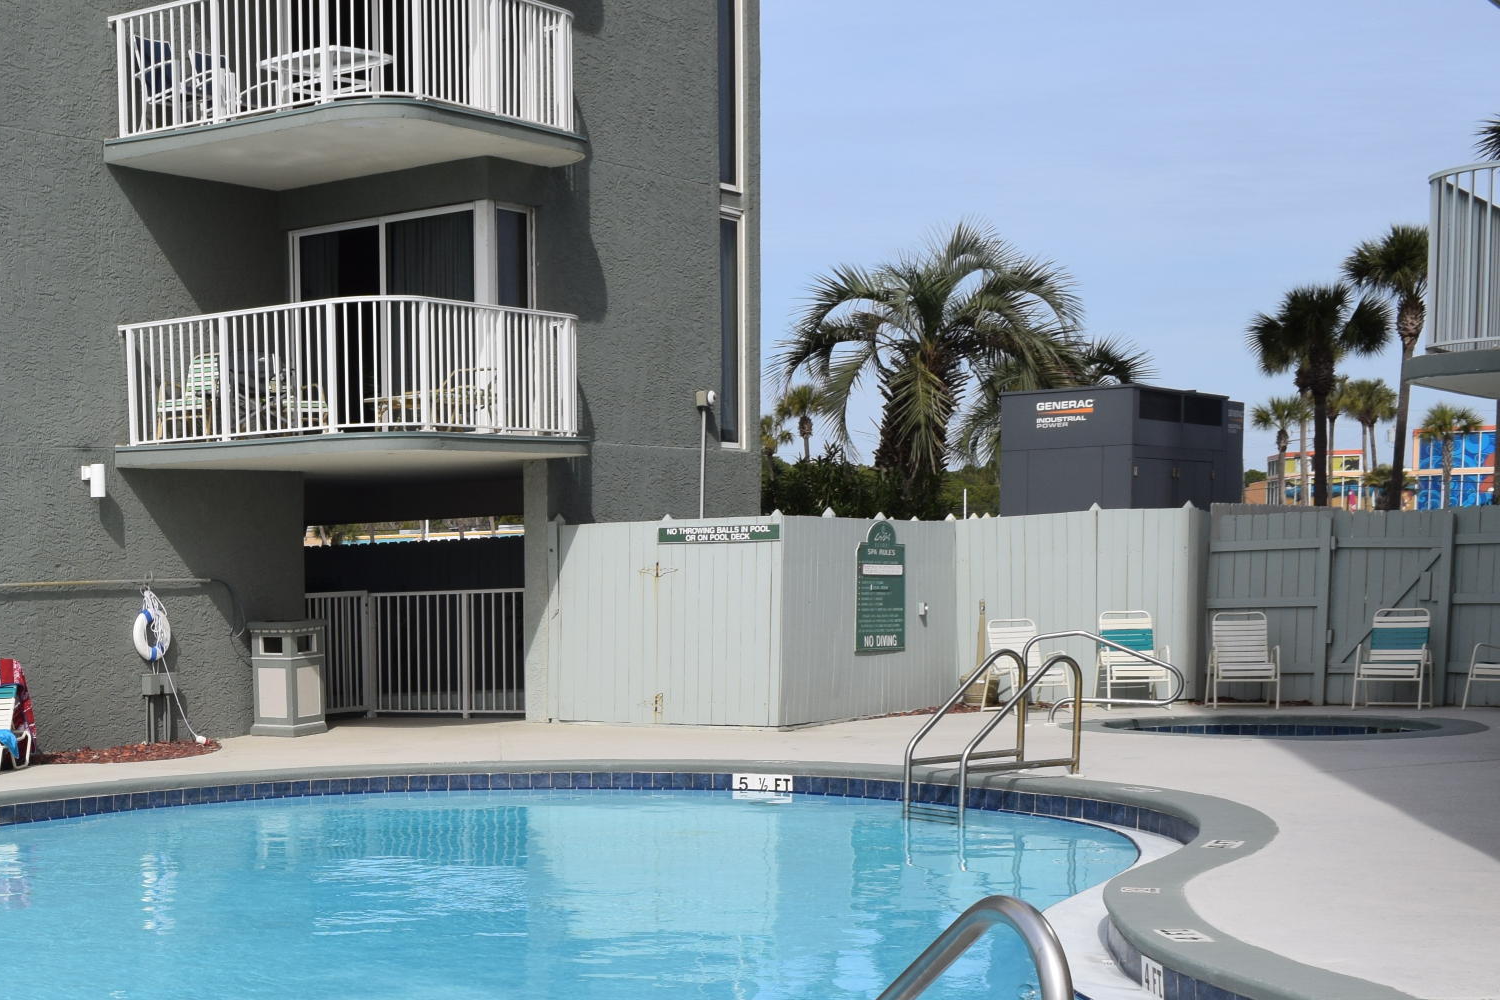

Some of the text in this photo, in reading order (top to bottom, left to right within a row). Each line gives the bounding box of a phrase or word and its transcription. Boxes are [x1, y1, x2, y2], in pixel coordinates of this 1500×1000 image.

[1036, 399, 1094, 411] GENERAC
[1036, 415, 1086, 424] INDUSTRIAL
[864, 633, 897, 647] NO DIVING
[739, 777, 748, 790] 5
[774, 778, 790, 792] FT
[1145, 962, 1163, 999] 4 FT
